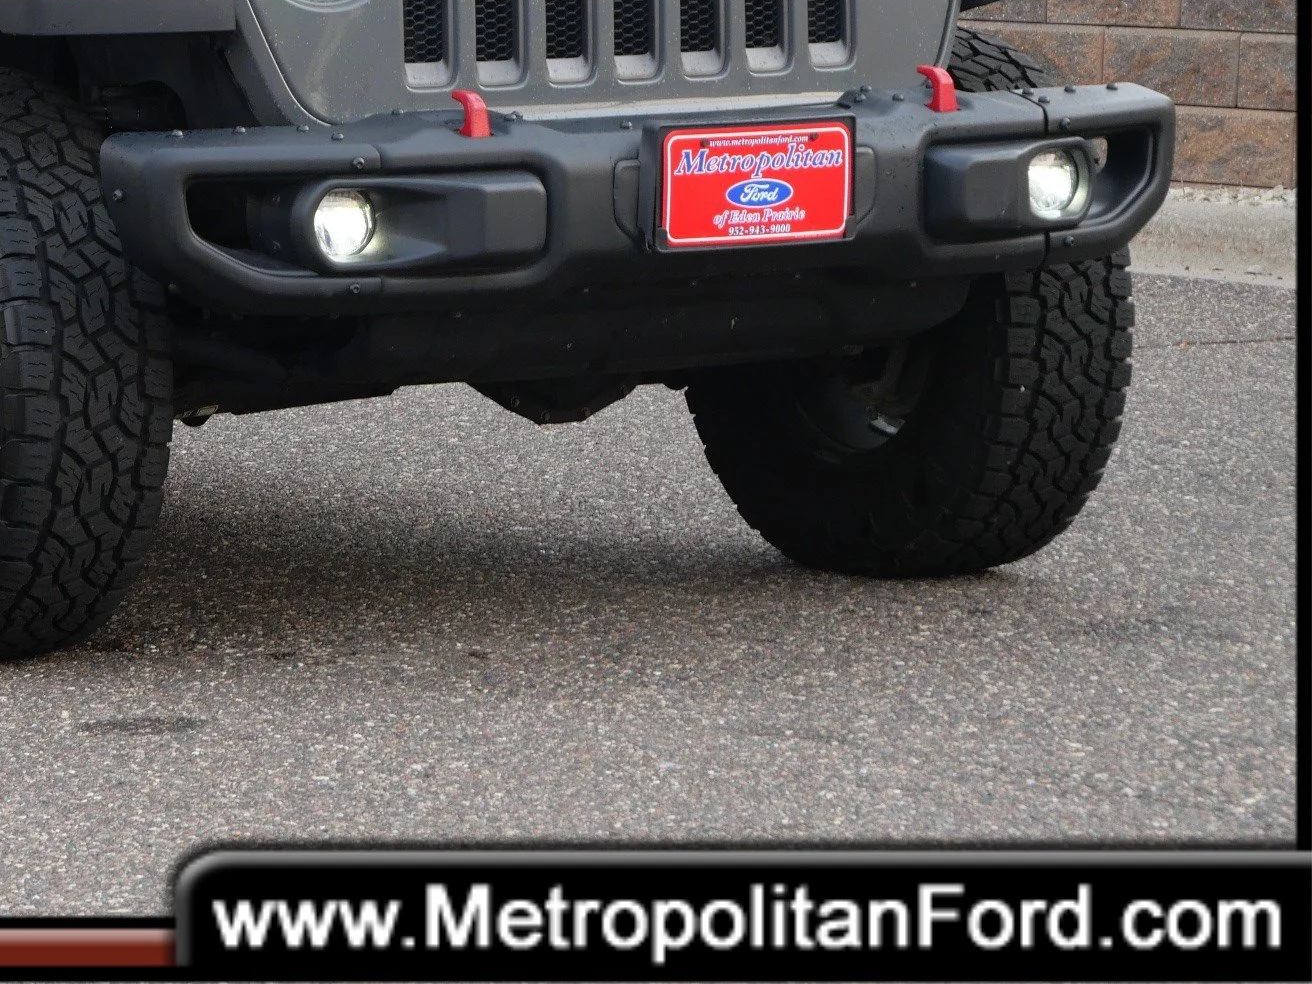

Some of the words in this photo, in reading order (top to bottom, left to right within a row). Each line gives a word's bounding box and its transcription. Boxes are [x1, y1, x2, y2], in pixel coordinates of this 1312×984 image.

[709, 134, 809, 148] www.metropolitanford.com
[673, 143, 843, 179] Metropolitan
[740, 183, 779, 203] Ford
[712, 209, 730, 229] of
[728, 208, 760, 224] Eden
[761, 206, 806, 222] Prairie
[728, 222, 791, 236] 952-943-9000
